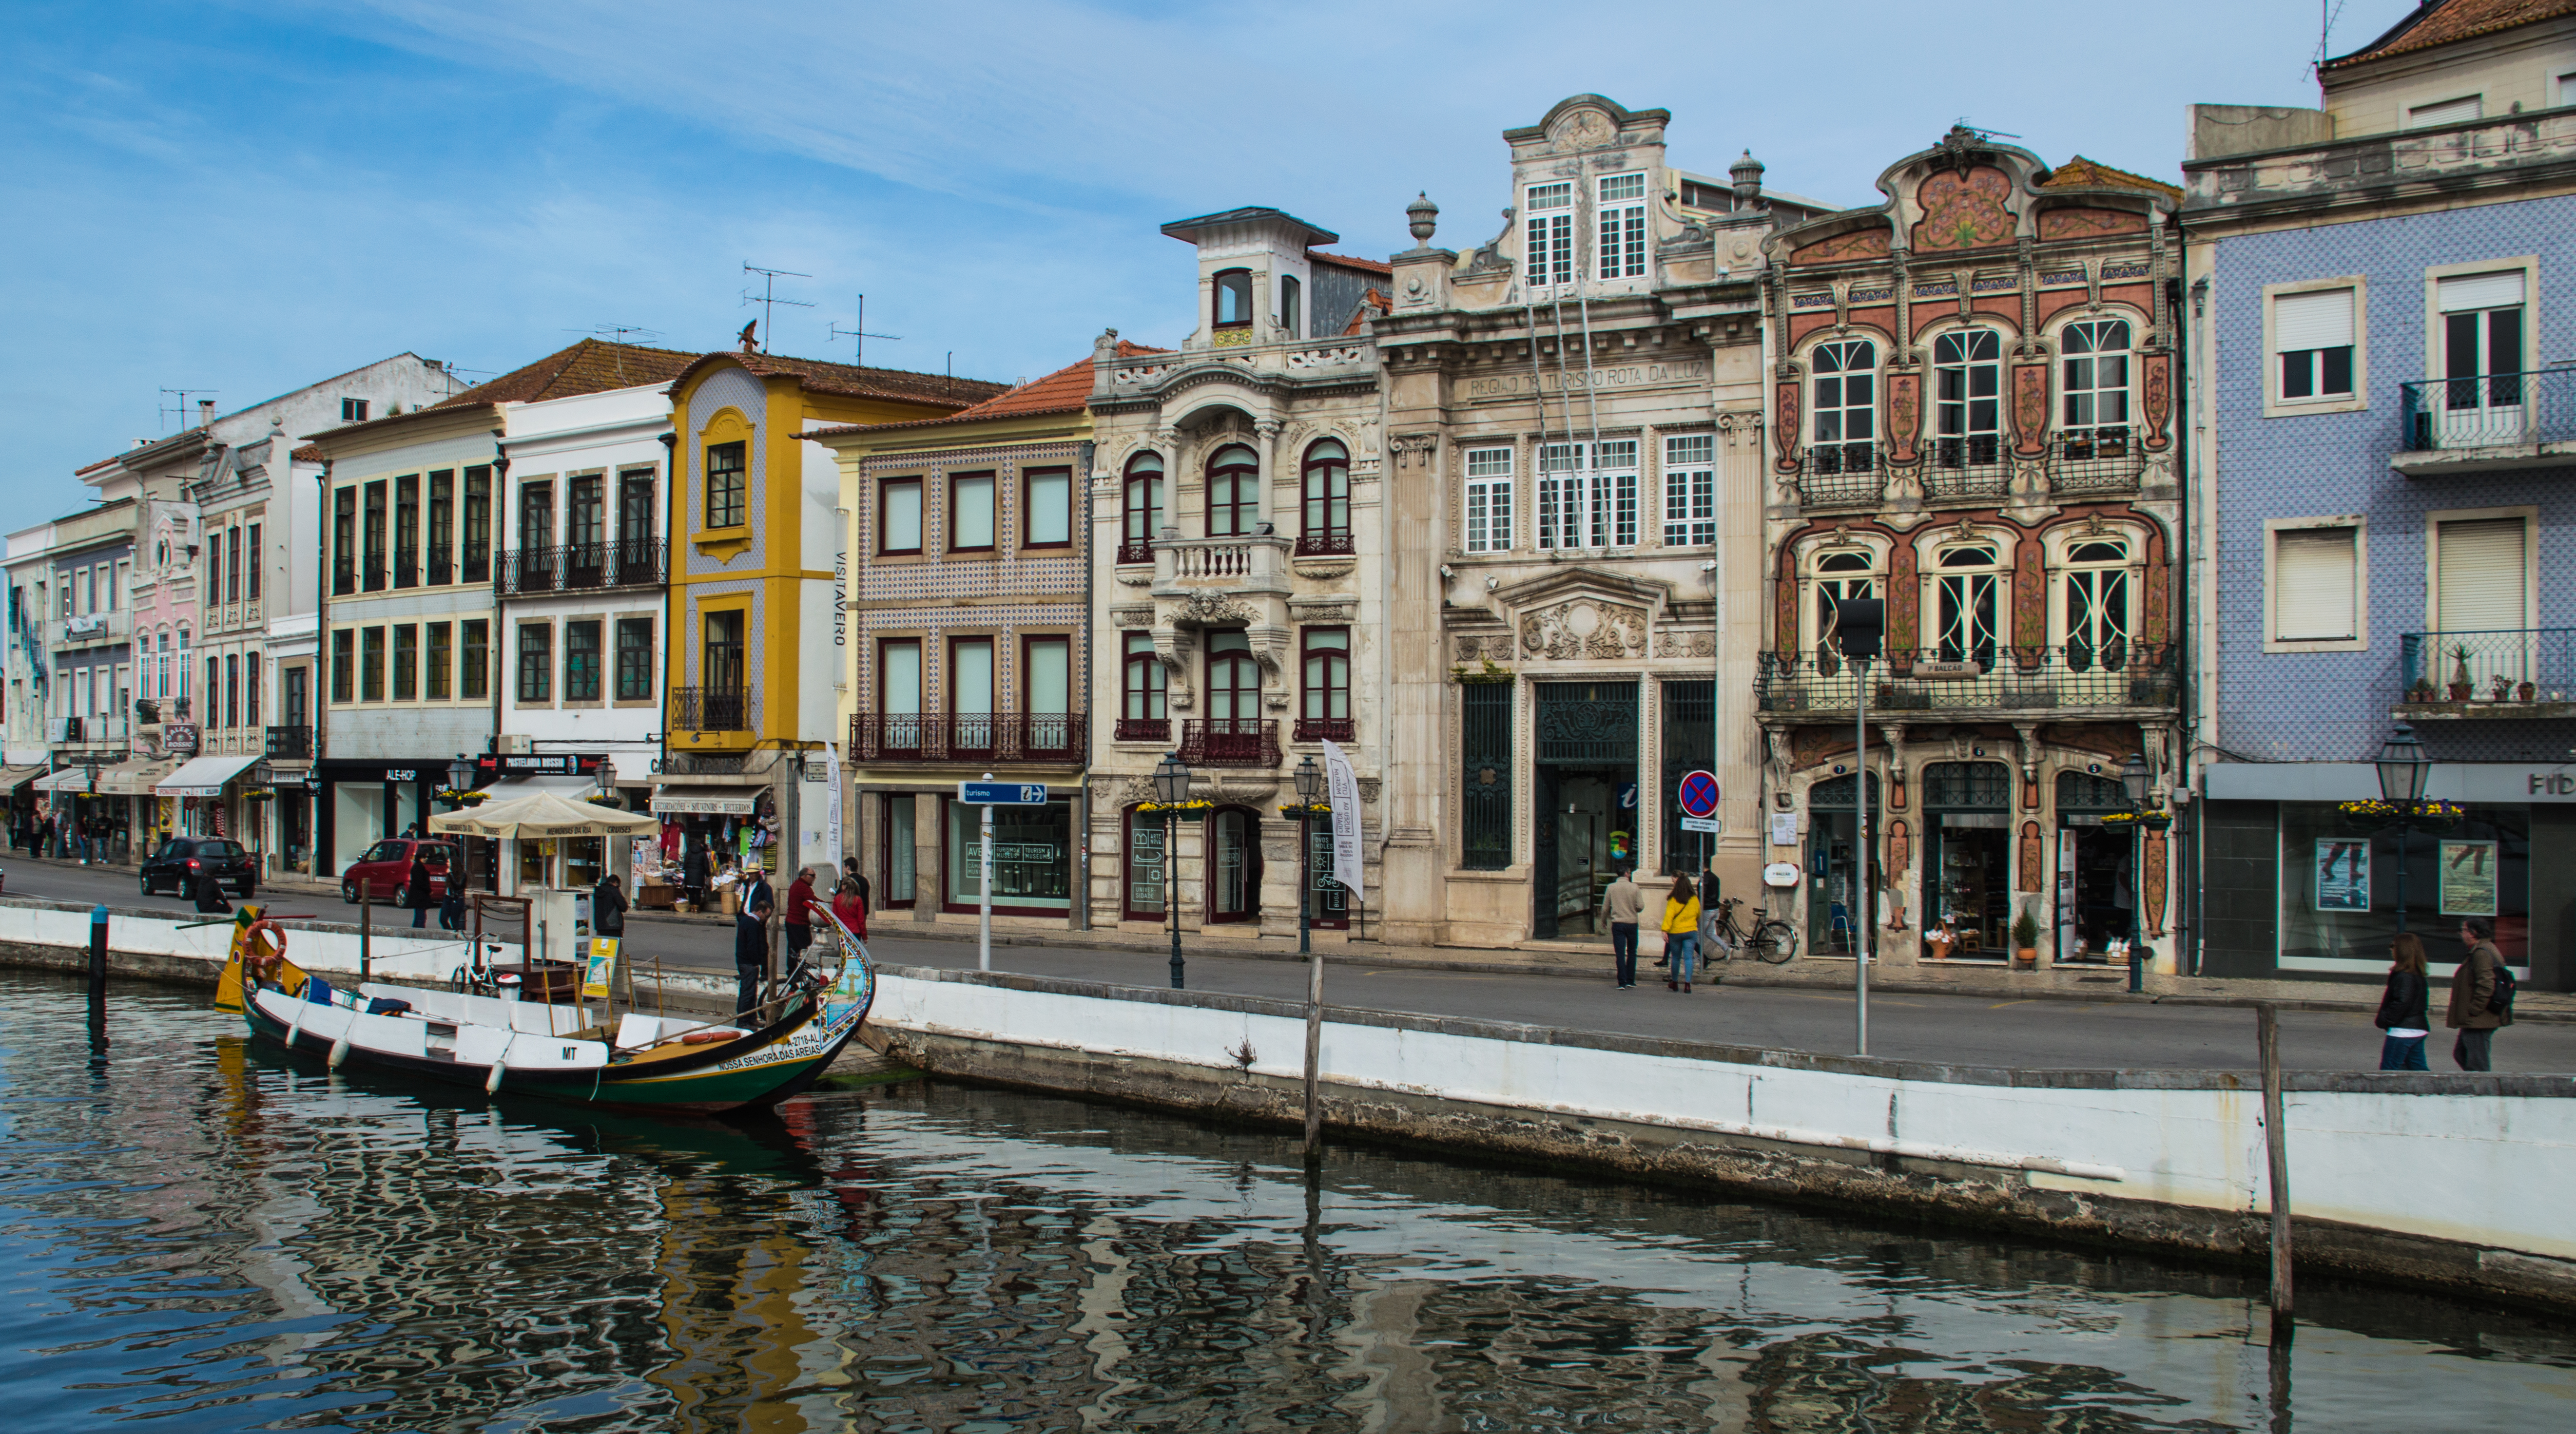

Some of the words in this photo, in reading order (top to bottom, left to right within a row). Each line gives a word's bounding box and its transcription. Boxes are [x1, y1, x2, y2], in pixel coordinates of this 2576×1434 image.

[1546, 371, 1603, 389] TURISMO
[1608, 368, 1642, 385] ROTA
[1649, 366, 1667, 381] DA
[1675, 362, 1703, 379] LUZ
[835, 552, 846, 646] VISITAVEIRO
[166, 726, 195, 741] GALERIA
[506, 758, 541, 767] PASTELARIA
[651, 758, 680, 773] CASA
[2092, 765, 2097, 773] 5
[385, 769, 416, 781] ALE-HOP
[692, 803, 717, 811] SOUVENIRS
[724, 803, 751, 812] RECUERDOS
[484, 827, 500, 835] CRUISES
[546, 825, 574, 835] MEMÓRIAS
[788, 1033, 819, 1048] A-2718-AL
[562, 1047, 578, 1060] MT
[718, 1059, 744, 1071] NOSSA
[744, 1052, 780, 1067] SENHORA
[780, 1049, 795, 1060] DAS
[795, 1044, 821, 1058] AREIAS
